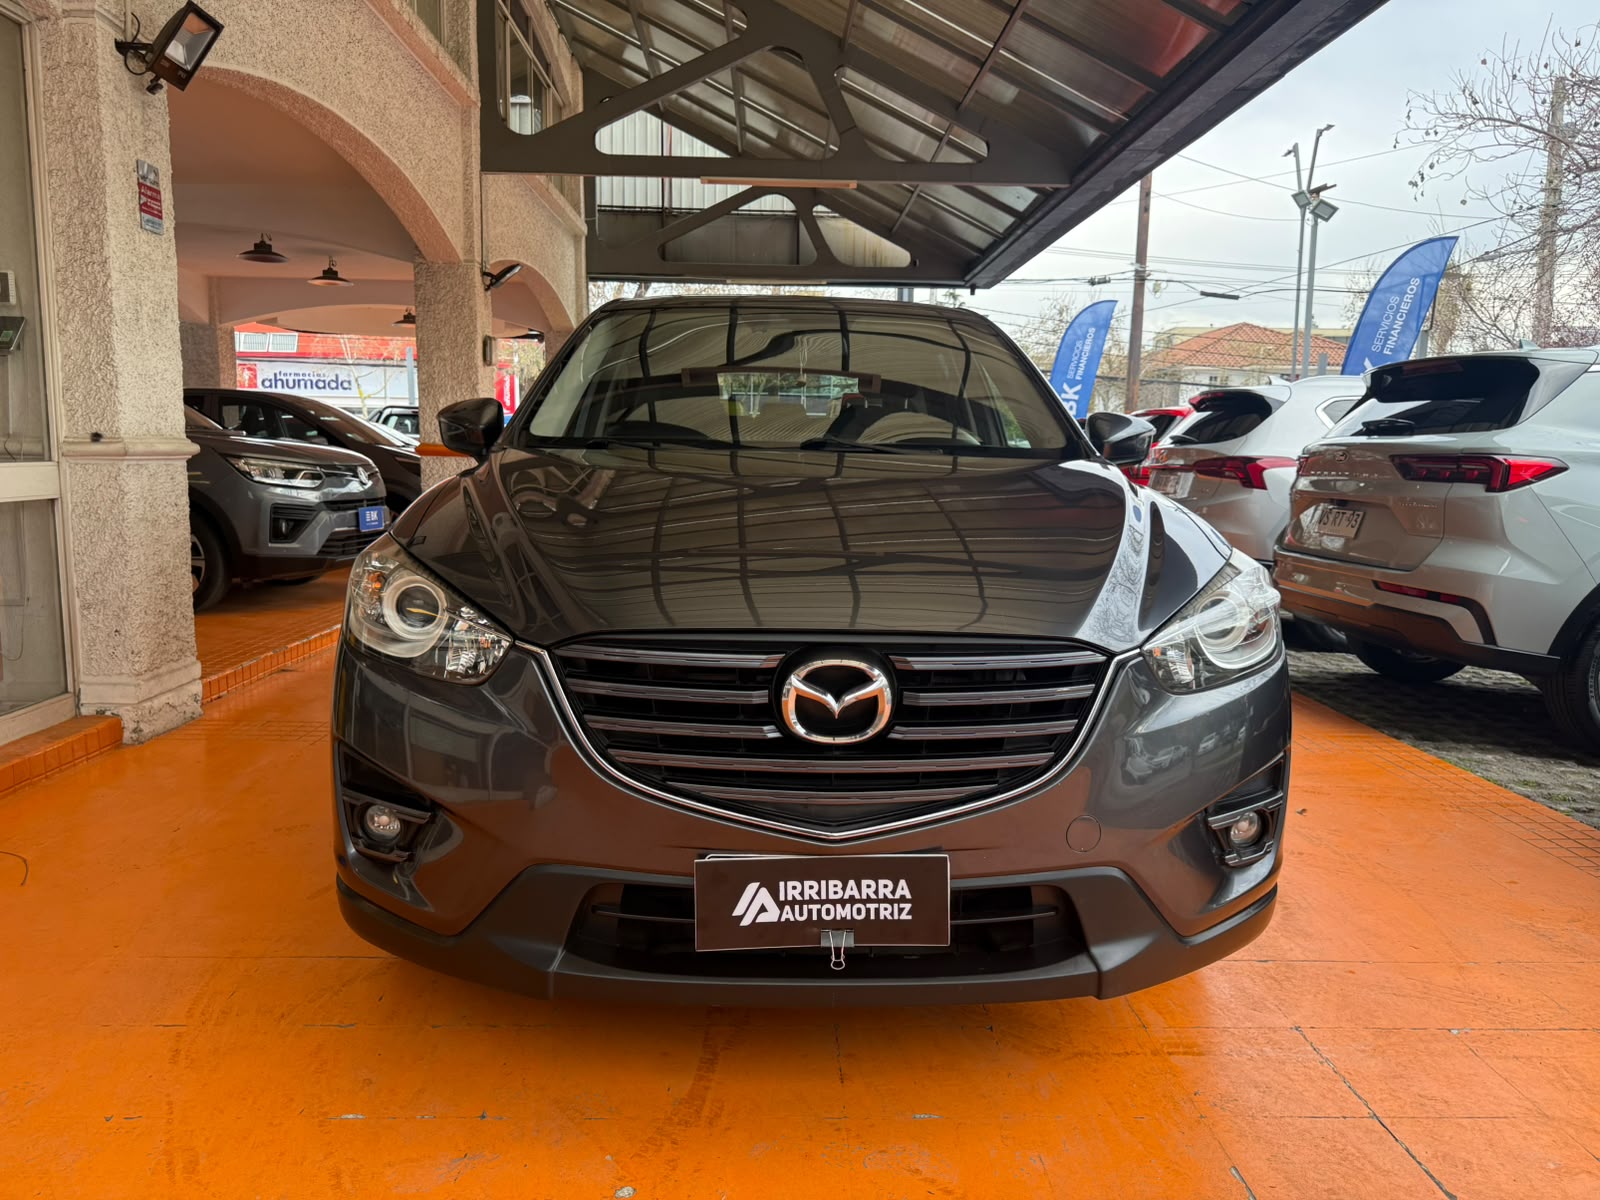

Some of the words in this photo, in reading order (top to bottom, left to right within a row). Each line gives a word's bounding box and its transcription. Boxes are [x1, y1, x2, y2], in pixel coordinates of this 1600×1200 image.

[1371, 296, 1400, 353] SERVICIOS
[1383, 277, 1421, 355] FINANCIEROS
[1067, 340, 1083, 379] SERVICIOS
[1075, 327, 1096, 380] FINANCIEROS
[261, 372, 353, 391] ahumada
[779, 879, 912, 901] IRRIBARRA
[780, 903, 913, 922] AUTOMOTRIZ
